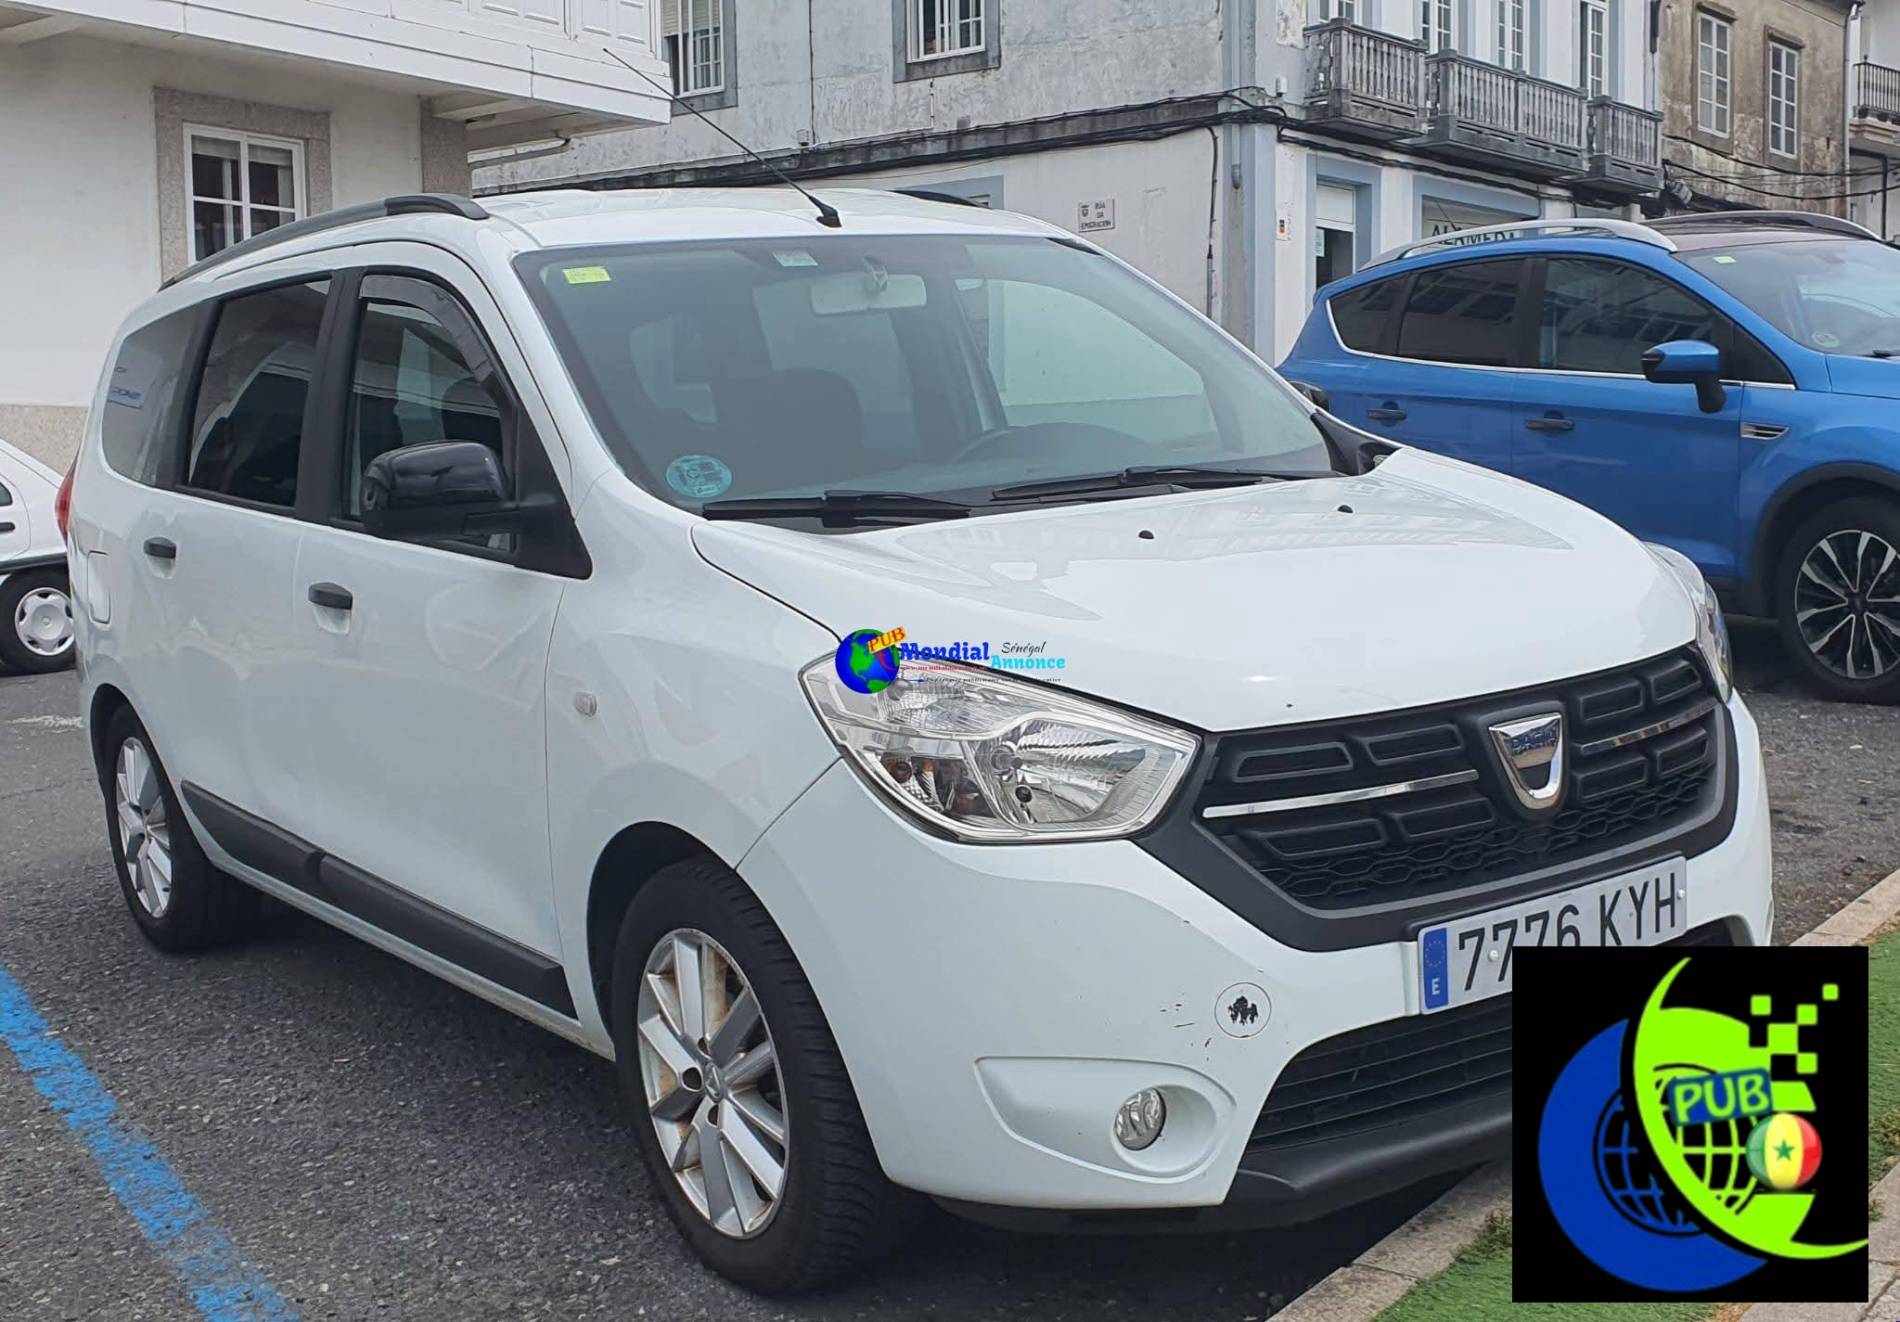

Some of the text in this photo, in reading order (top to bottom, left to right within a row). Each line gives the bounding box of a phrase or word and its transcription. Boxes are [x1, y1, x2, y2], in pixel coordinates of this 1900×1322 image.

[1459, 872, 1675, 991] 7776 KYH
[1431, 977, 1441, 996] E
